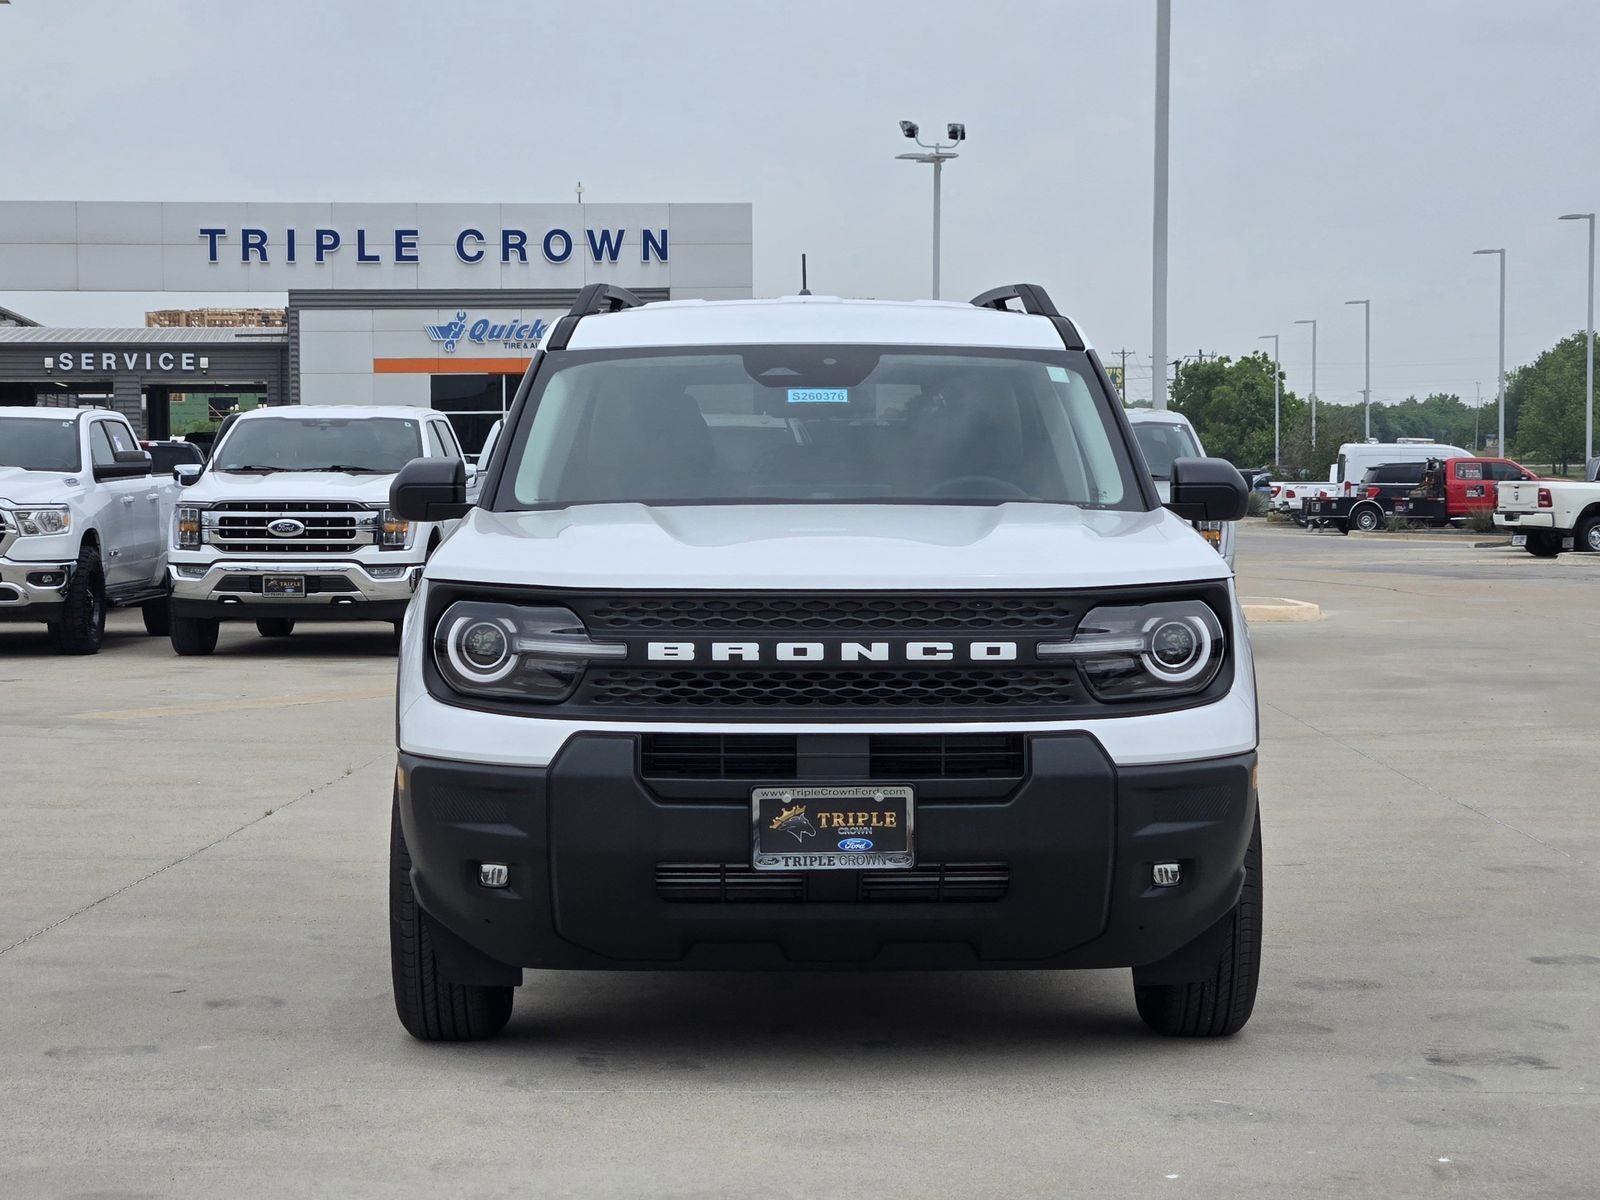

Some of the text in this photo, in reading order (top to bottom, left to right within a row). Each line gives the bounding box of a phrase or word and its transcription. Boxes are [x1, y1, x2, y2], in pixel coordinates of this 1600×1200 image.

[199, 228, 669, 264] TRIPLE CROWN
[503, 342, 521, 350] TIRE
[523, 342, 528, 350] &
[58, 352, 196, 371] SERVICE
[791, 391, 846, 401] S260376
[276, 522, 295, 532] Ford
[647, 641, 1017, 662] BRONCO
[817, 812, 897, 828] TRIPLE
[838, 827, 873, 835] CROWN
[844, 840, 867, 849] Ford
[781, 855, 887, 867] TRIPLE CROWN
